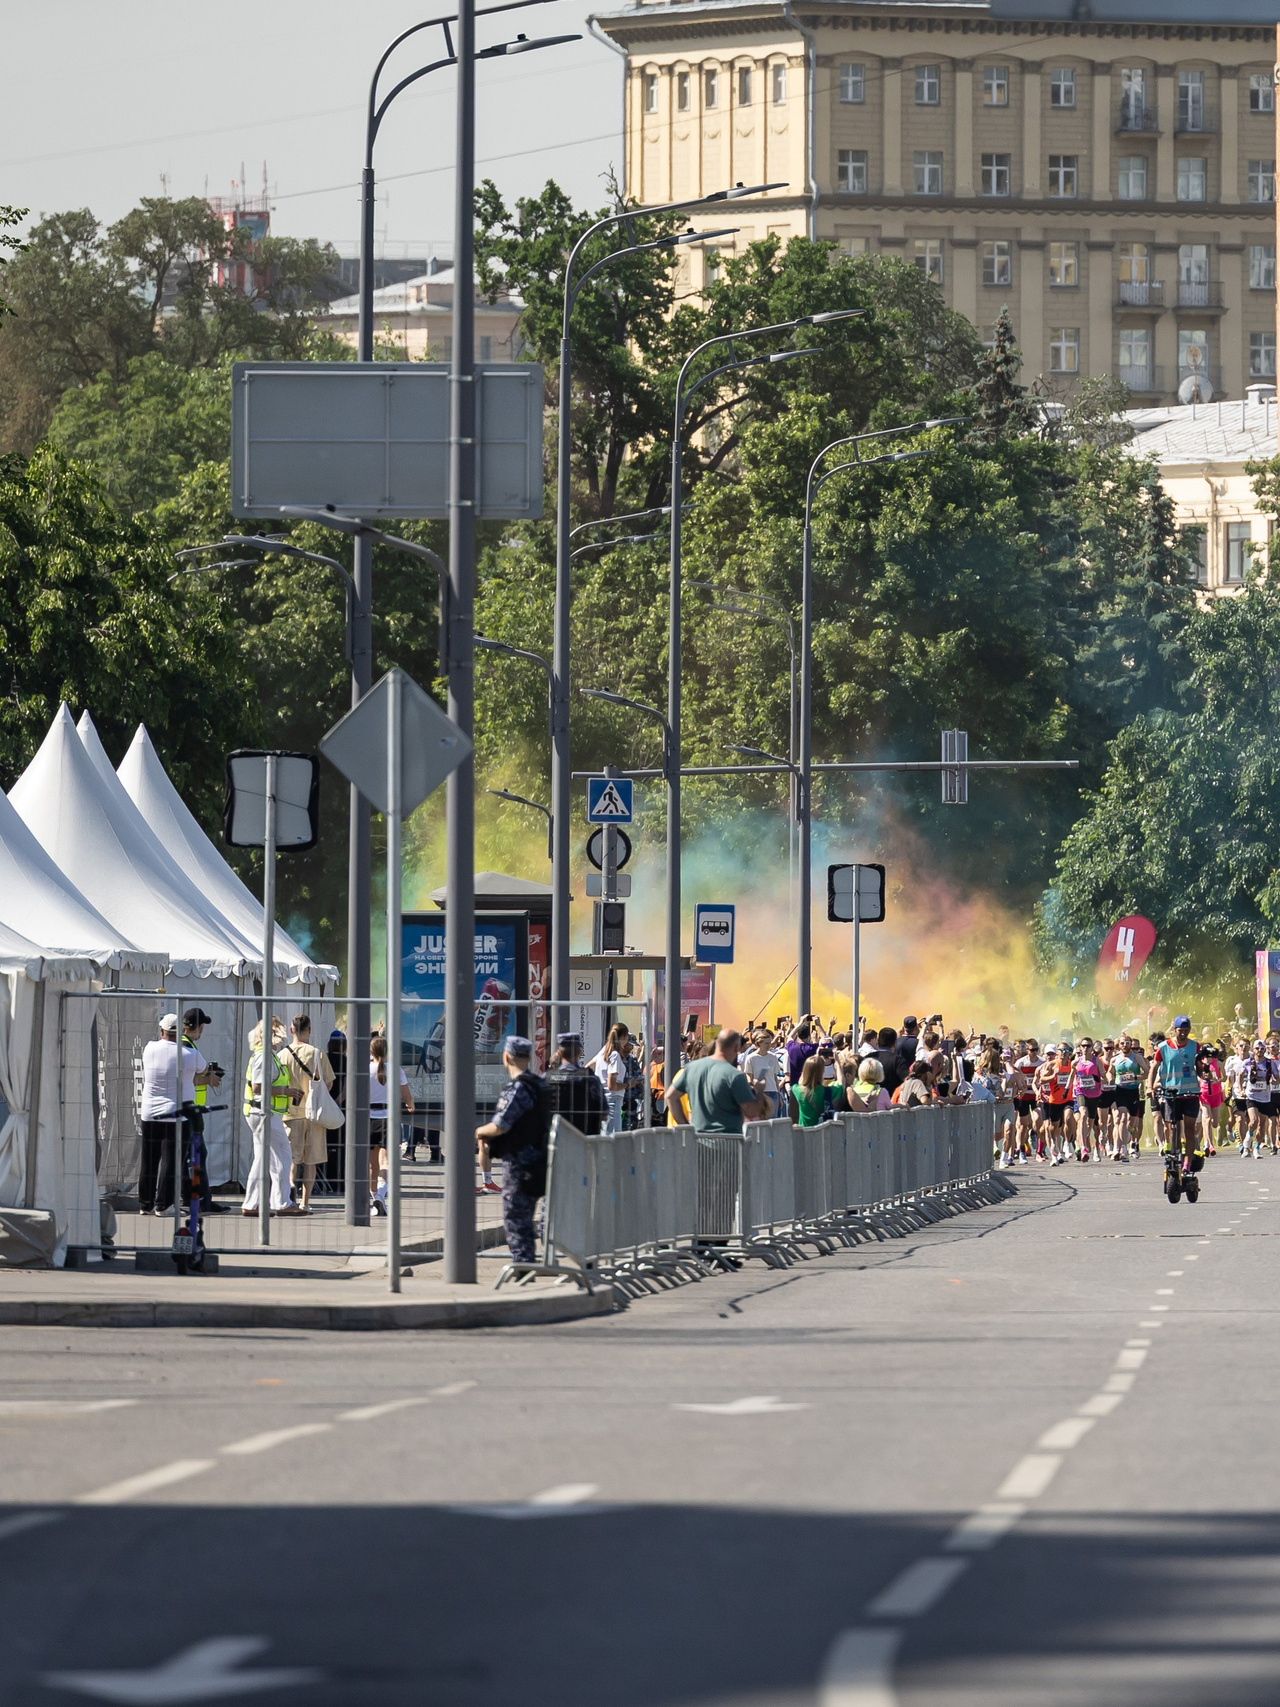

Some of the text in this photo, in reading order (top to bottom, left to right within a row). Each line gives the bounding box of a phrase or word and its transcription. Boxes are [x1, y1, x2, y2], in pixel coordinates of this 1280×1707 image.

[414, 935, 498, 953] JUER
[1116, 927, 1134, 967] 4
[577, 981, 591, 991] 2D
